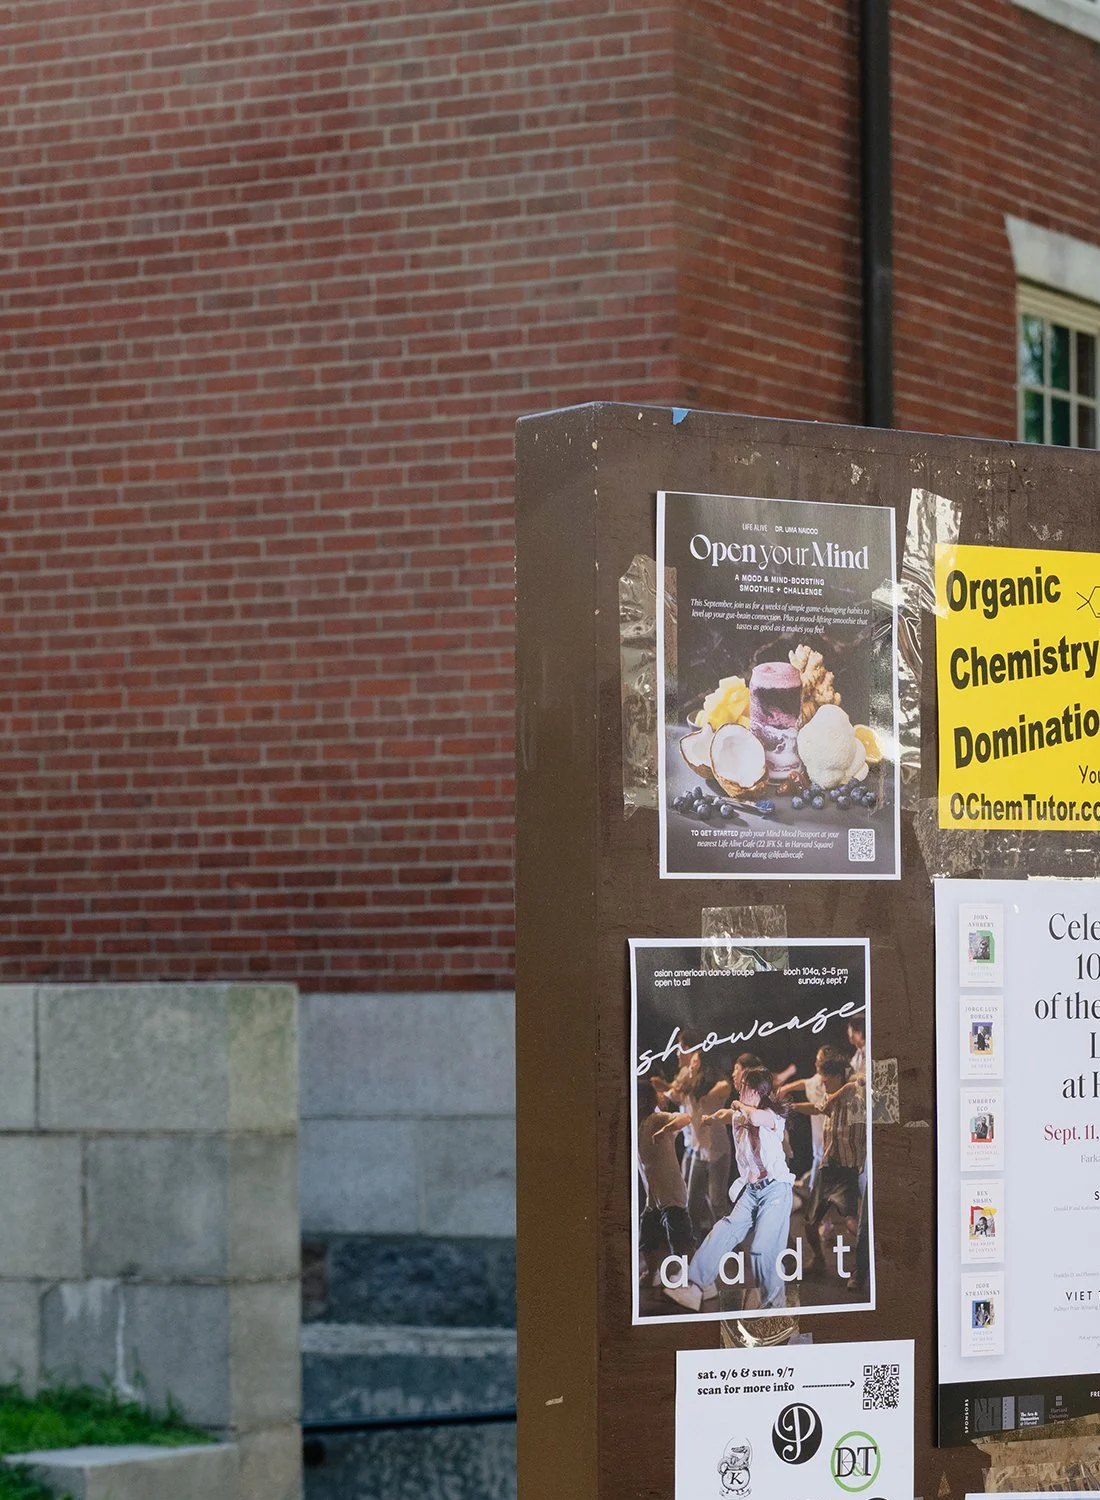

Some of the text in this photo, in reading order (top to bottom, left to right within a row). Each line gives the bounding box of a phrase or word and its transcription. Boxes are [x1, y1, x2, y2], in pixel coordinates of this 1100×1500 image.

[690, 534, 869, 570] Open your Mind
[771, 576, 825, 586] MIND-BOOSTING
[739, 584, 773, 593] SMOOTHIE
[784, 587, 823, 596] CHALLENGE
[946, 566, 1061, 619] Organic
[950, 636, 1099, 690] Chemistry
[654, 969, 673, 977] asian
[732, 969, 754, 978] troupe
[784, 967, 848, 977] soch 104a, 3–5 pm
[654, 978, 690, 987] open to all
[798, 976, 848, 986] sunday, sept 7
[1035, 992, 1061, 1020] of
[637, 1001, 866, 1076] showcase
[1062, 1073, 1085, 1098] at
[1044, 1123, 1080, 1145] Sept.
[1085, 1123, 1099, 1141] 11,
[1066, 1290, 1093, 1301] VIET
[698, 1367, 794, 1380] sat. 9/6 & sun. 9/7
